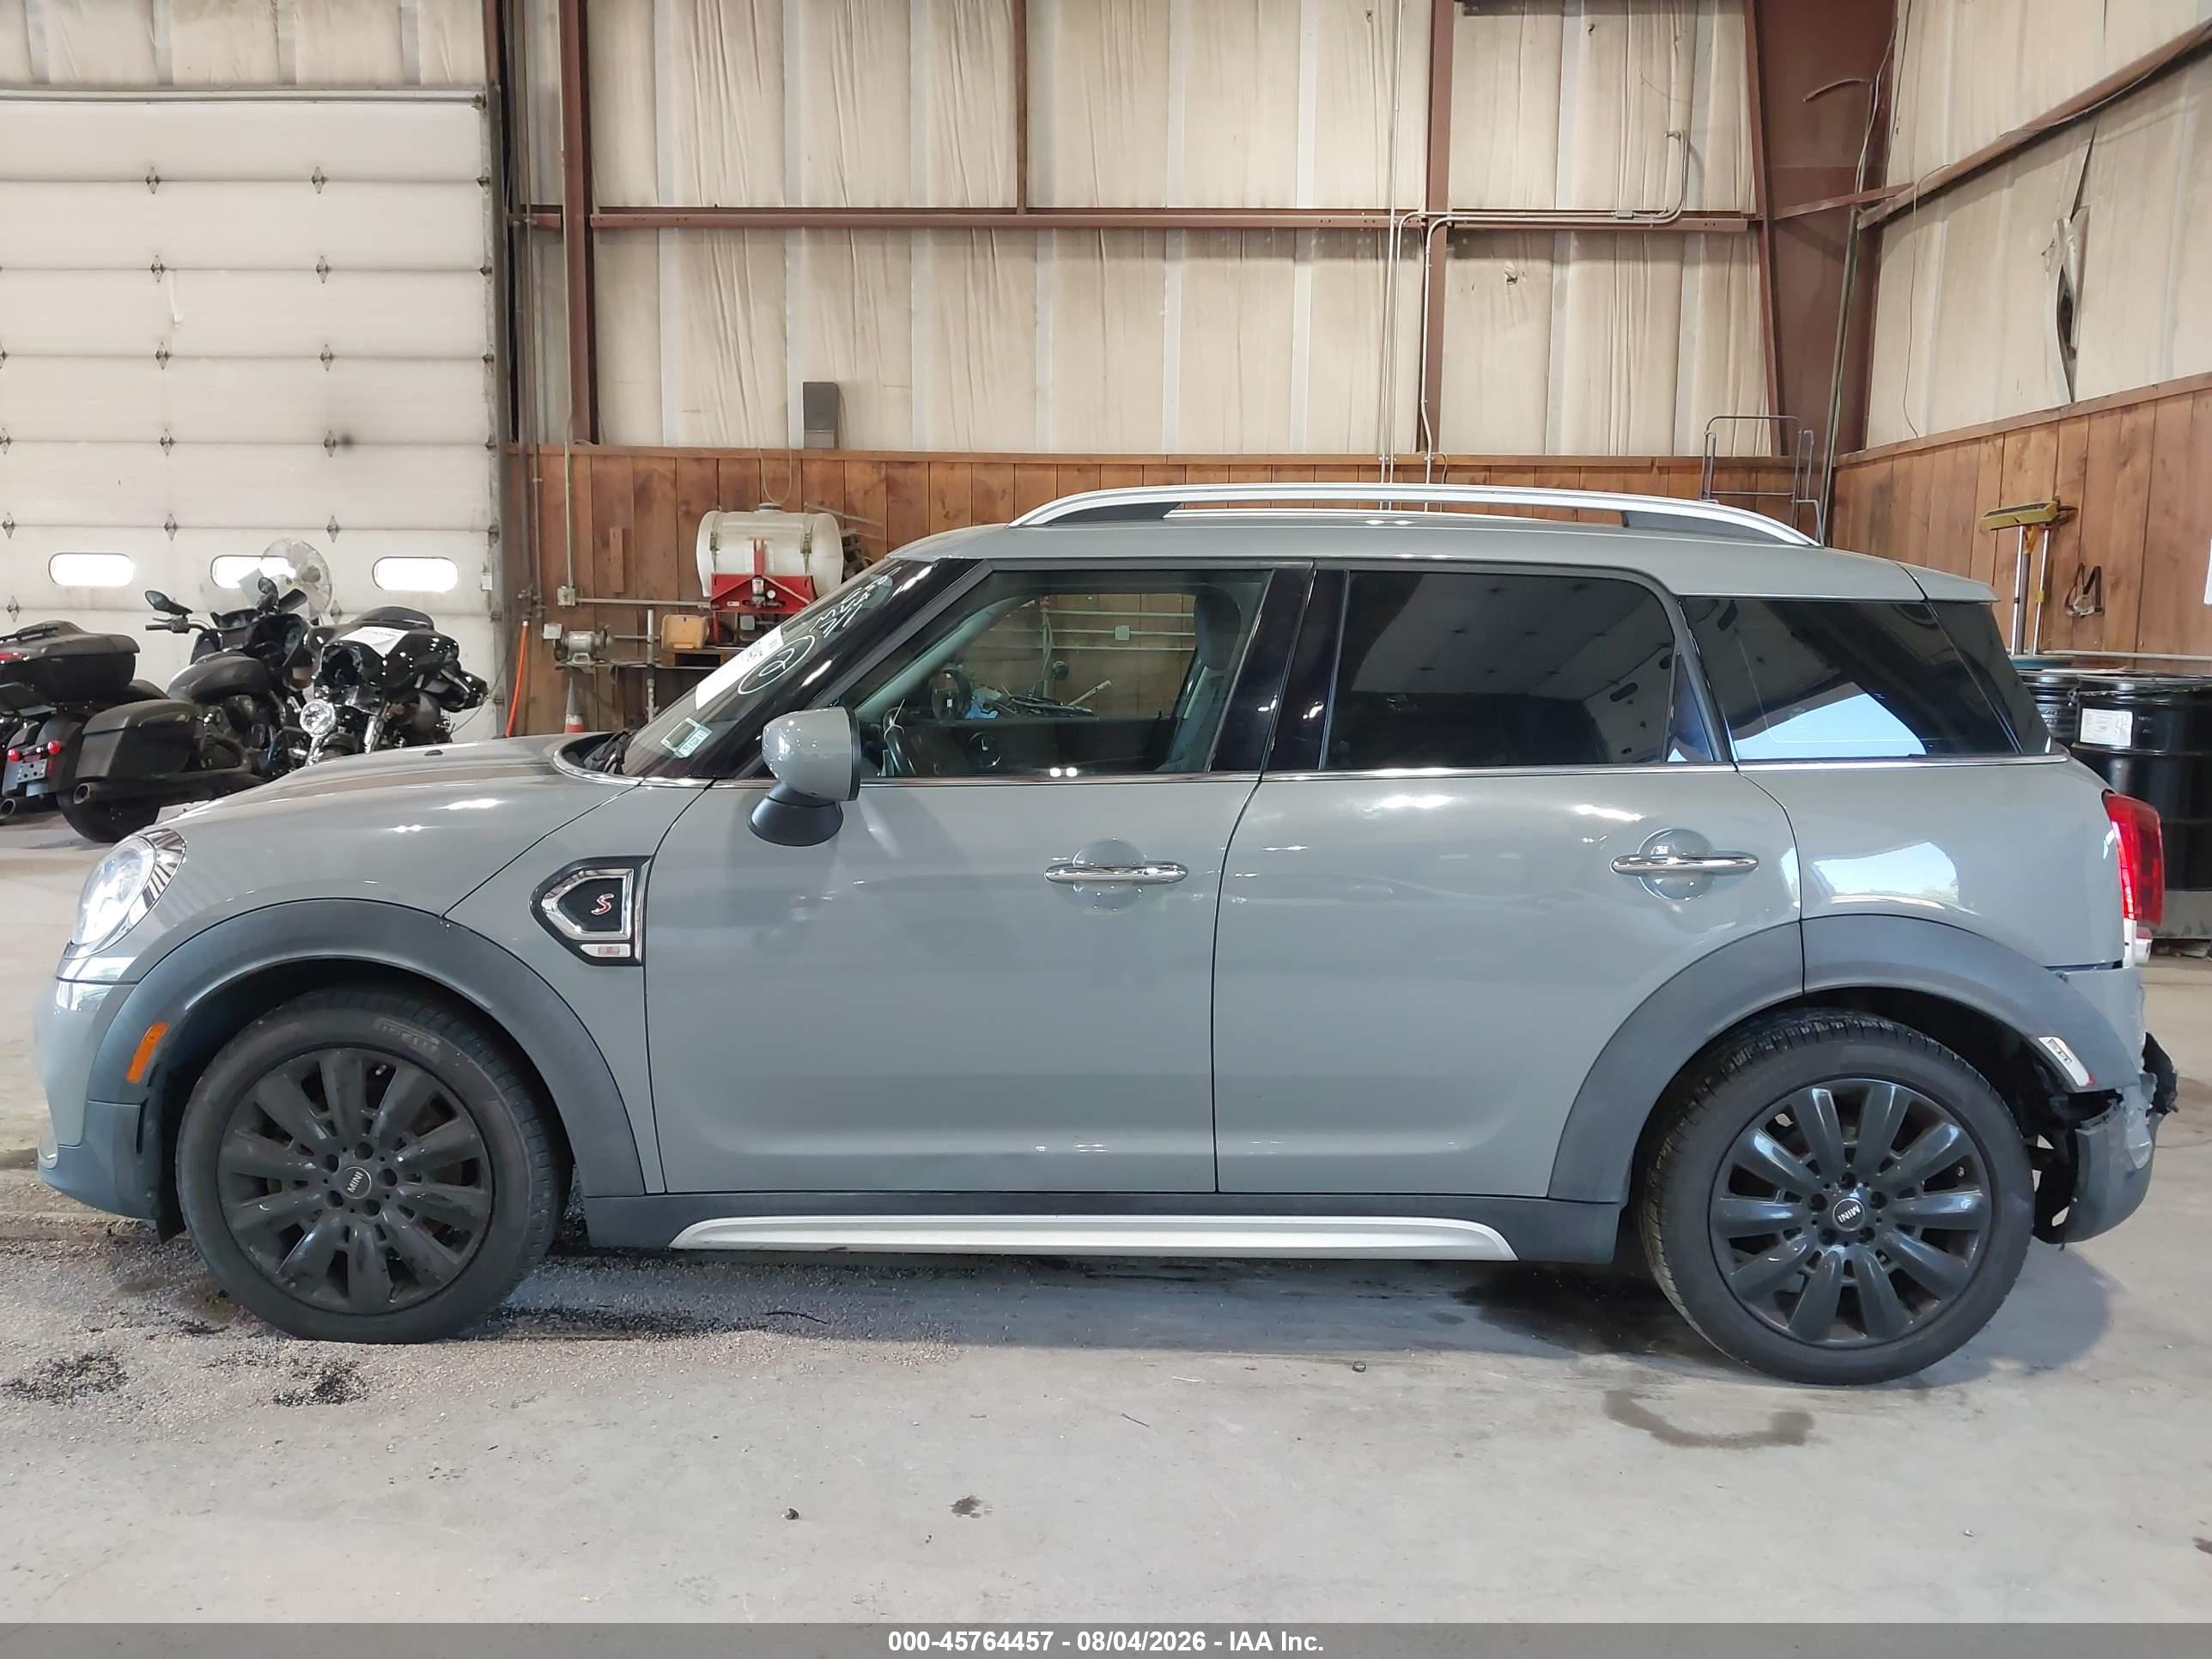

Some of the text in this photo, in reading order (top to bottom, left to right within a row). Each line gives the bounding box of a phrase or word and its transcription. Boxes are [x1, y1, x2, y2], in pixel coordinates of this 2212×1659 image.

[590, 893, 615, 916] S
[346, 1170, 365, 1194] MINI
[1837, 1204, 1862, 1224] MINI
